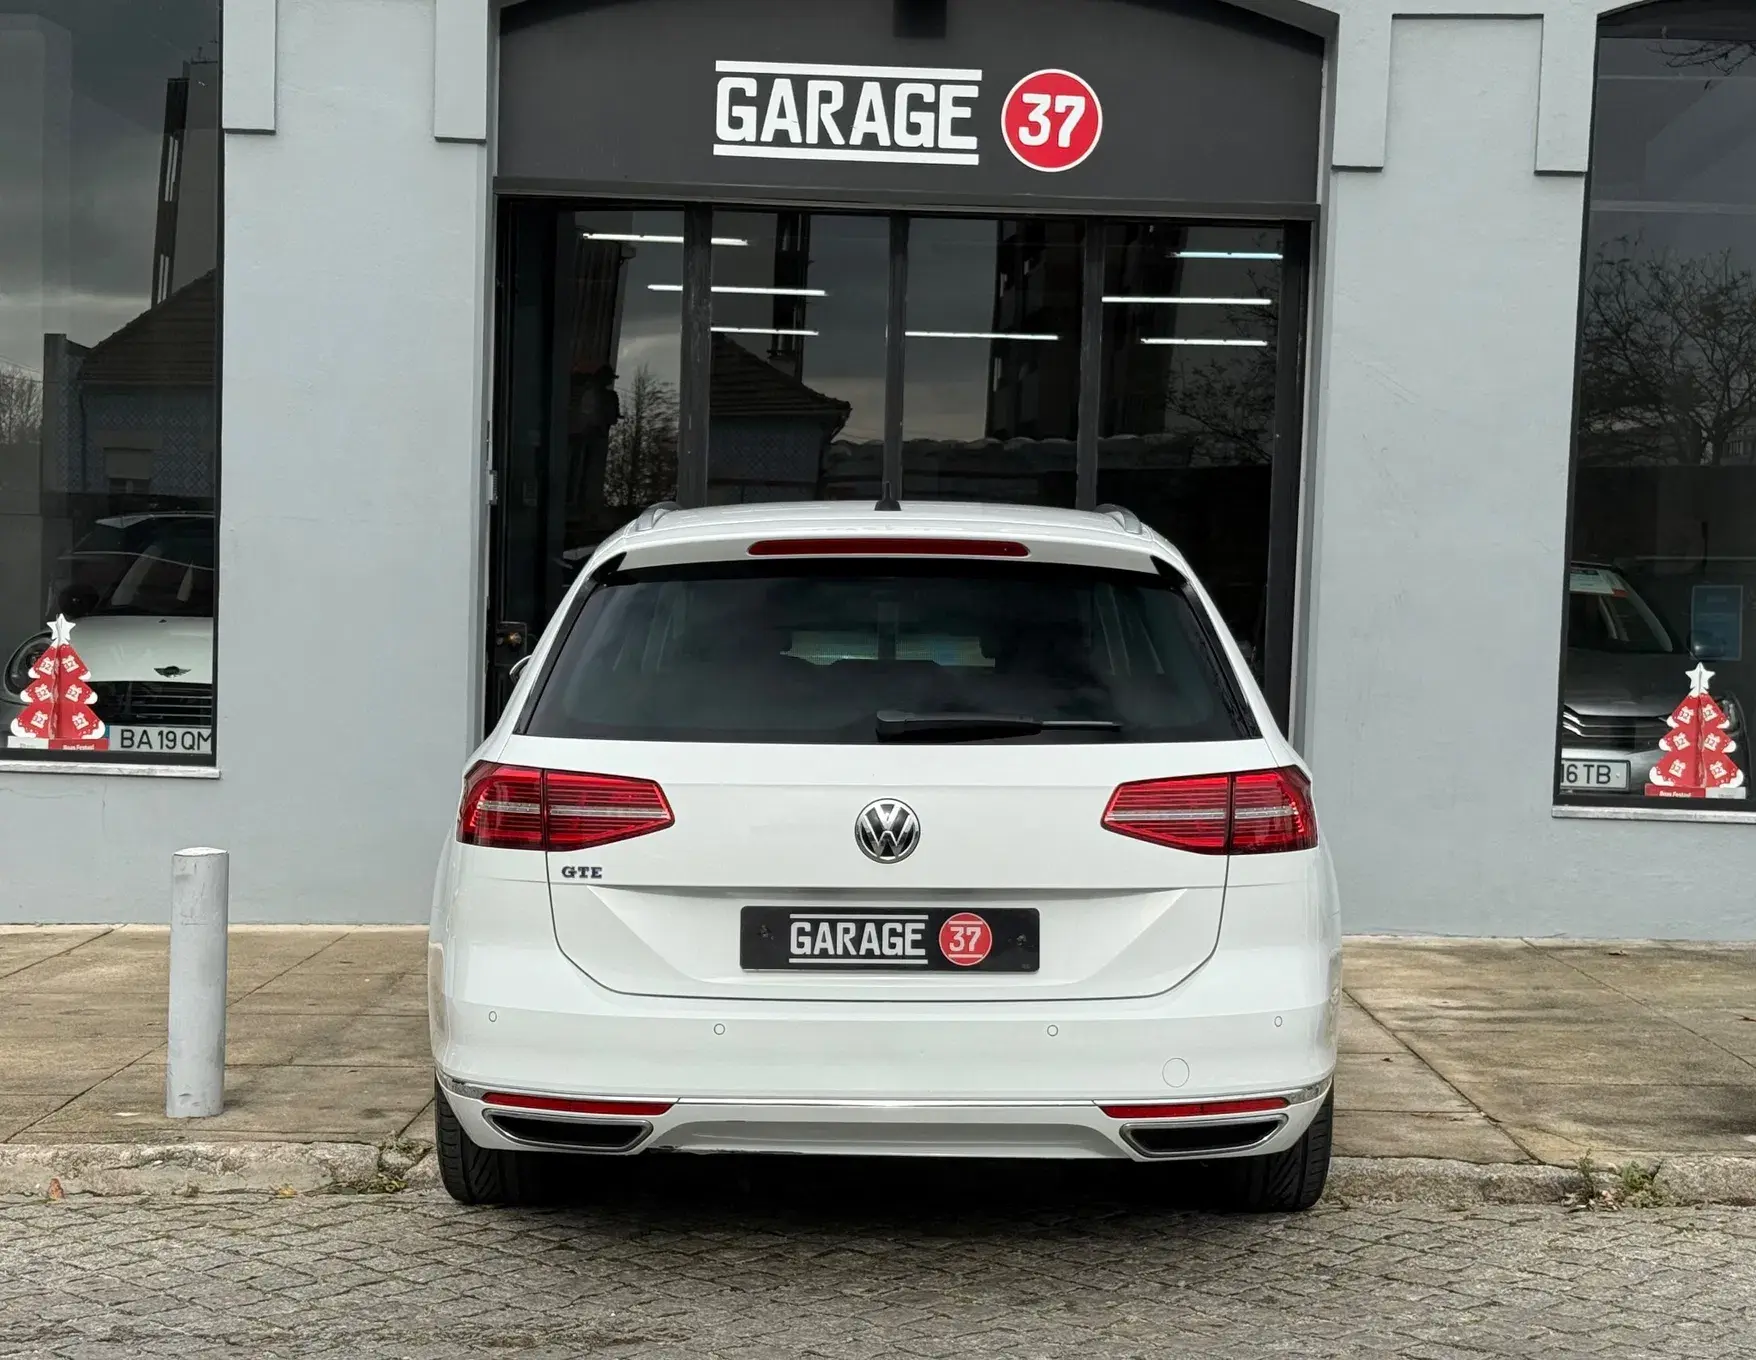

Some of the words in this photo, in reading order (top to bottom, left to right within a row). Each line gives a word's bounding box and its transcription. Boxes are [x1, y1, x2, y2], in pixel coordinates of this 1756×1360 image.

[716, 76, 979, 150] GARAGE
[1018, 93, 1085, 148] 37
[121, 729, 153, 750] BA
[158, 730, 177, 750] 19
[181, 731, 212, 751] QM
[1583, 764, 1611, 784] TB
[561, 866, 603, 879] GTE
[790, 921, 926, 957] GARAGE
[949, 926, 982, 952] 37
